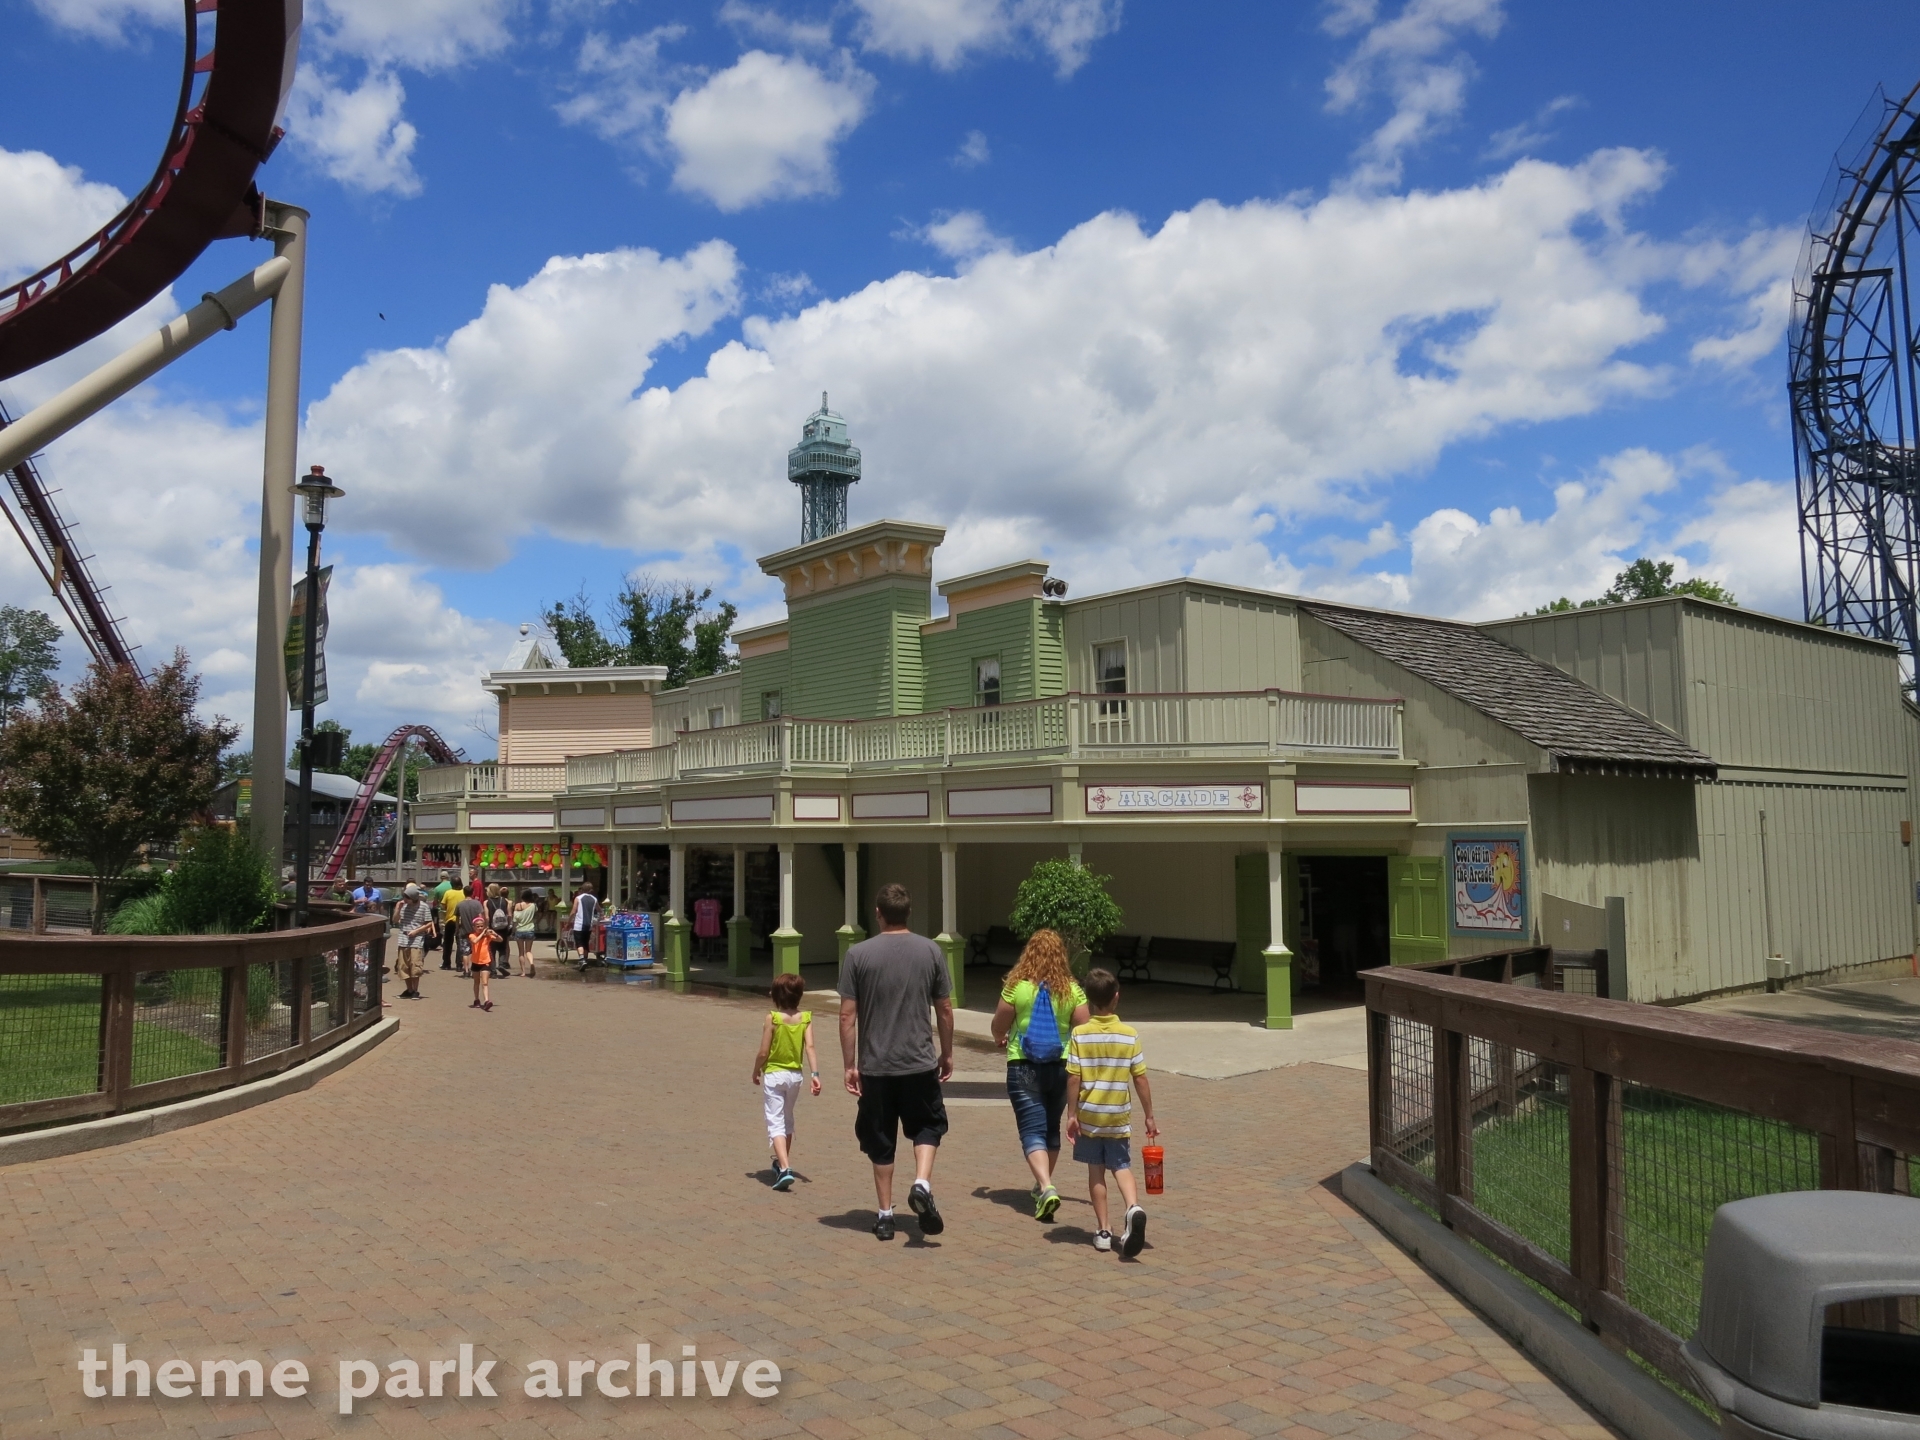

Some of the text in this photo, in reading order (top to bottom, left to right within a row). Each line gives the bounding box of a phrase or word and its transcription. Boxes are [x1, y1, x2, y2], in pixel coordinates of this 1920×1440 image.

[1118, 789, 1230, 807] ARCADE
[1455, 846, 1491, 864] Cool off in
[1456, 866, 1496, 884] the Arcade!
